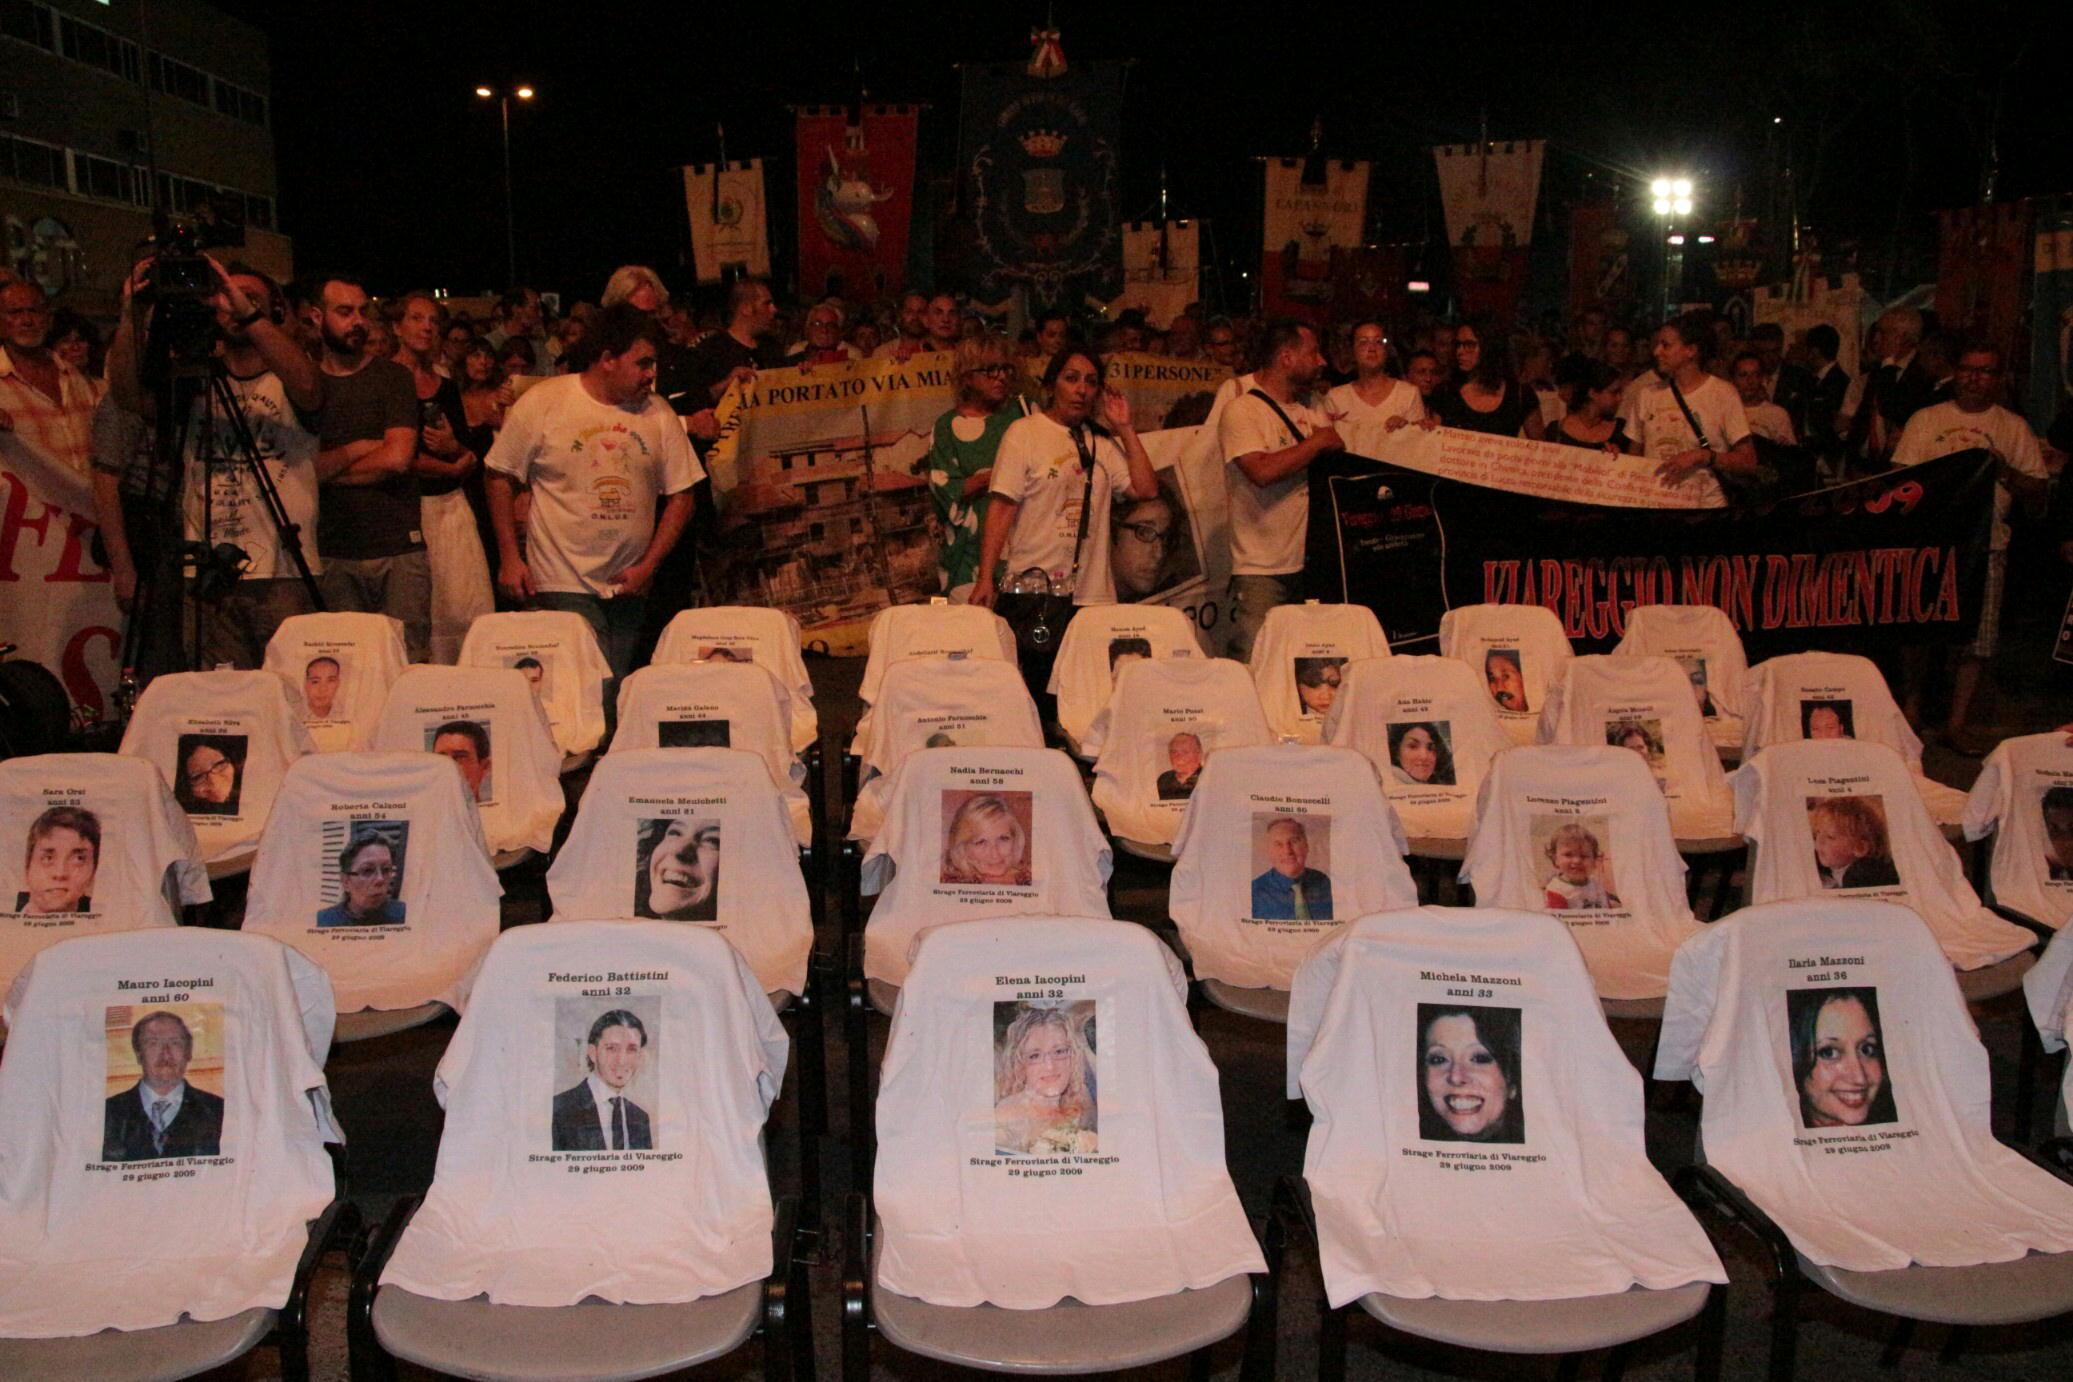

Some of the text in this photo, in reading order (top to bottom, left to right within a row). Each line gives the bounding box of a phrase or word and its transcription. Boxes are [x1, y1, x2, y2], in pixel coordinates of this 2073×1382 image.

[768, 378, 866, 405] PORTATO
[868, 373, 910, 392] VIA
[1482, 545, 1960, 639] VIAREGGIO NON DIMENTICA
[950, 766, 1023, 776] Nadia Bernacchi
[970, 777, 990, 785] anni
[1828, 776, 1870, 785] Piagentini
[43, 788, 86, 796] Sara Orsi
[628, 796, 727, 805] Emanuela Menichetti
[1250, 794, 1331, 805] Claudio Bonuccelli
[1526, 796, 1607, 806] Lorenzo Piagentini
[331, 803, 370, 811] Roberta
[970, 897, 994, 905] giugno
[1788, 956, 1864, 969] Ilaria Mazzoni
[548, 971, 669, 983] Federico Battistini
[995, 974, 1086, 986] Elena Iacopini
[1420, 971, 1522, 986] Michela Mazzoni
[1806, 971, 1847, 983] anni 36
[117, 977, 214, 990] Mauro Iacopini
[582, 987, 631, 997] anni 32
[1016, 988, 1064, 999] anni 32
[1447, 986, 1493, 999] anni 33
[142, 993, 190, 1004] anni 60
[1817, 1134, 1866, 1146] Ferroviaria
[1868, 1133, 1876, 1141] di
[1878, 1129, 1919, 1140] Viareggio
[1824, 1143, 1890, 1154] 29 giugno 2009
[528, 1152, 683, 1163] Strage Ferroviaria di Viareggio
[1401, 1148, 1546, 1163] Strage Ferroviaria di Viareggio
[84, 1157, 235, 1174] Strage Ferroviaria di Viareggio
[970, 1155, 1120, 1168] Strage Ferroviaria di Viareggio
[1438, 1162, 1450, 1170] 29
[1453, 1162, 1487, 1172] giugno
[567, 1164, 645, 1174] 29 giugno 2009
[1007, 1167, 1083, 1178] 29 giugno 2009
[122, 1169, 196, 1182] 29 giugno 2009
